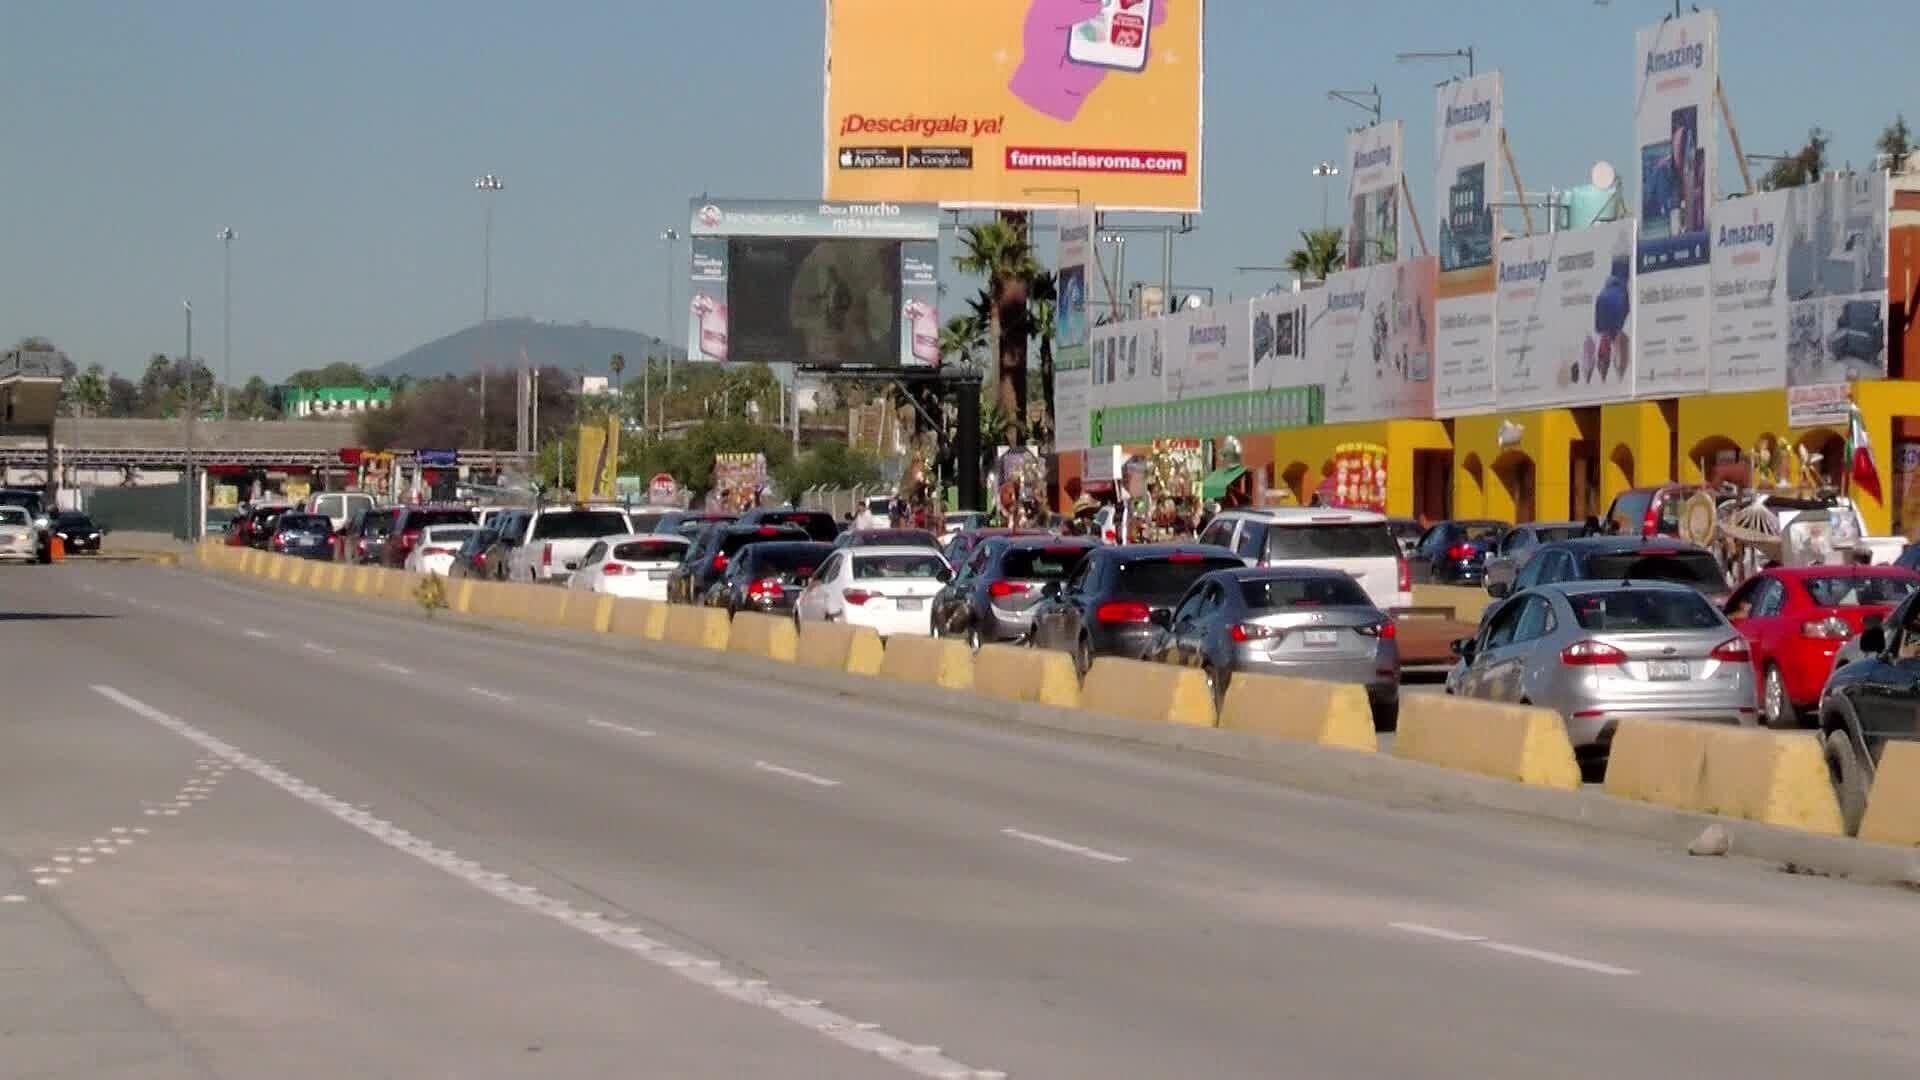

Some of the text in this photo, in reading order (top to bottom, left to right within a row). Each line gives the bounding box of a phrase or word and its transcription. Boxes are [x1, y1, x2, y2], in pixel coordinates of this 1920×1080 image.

[1644, 40, 1704, 75] Amazing
[840, 114, 1005, 138] ¡Descárgala ya!
[1445, 100, 1492, 128] Amazing
[875, 154, 901, 167] Store
[1010, 150, 1184, 171] farmaciasroma.com
[1352, 145, 1392, 169] Amazing
[849, 202, 901, 216] mucho
[1717, 218, 1776, 248] Amazing
[1500, 258, 1547, 282] Amazing
